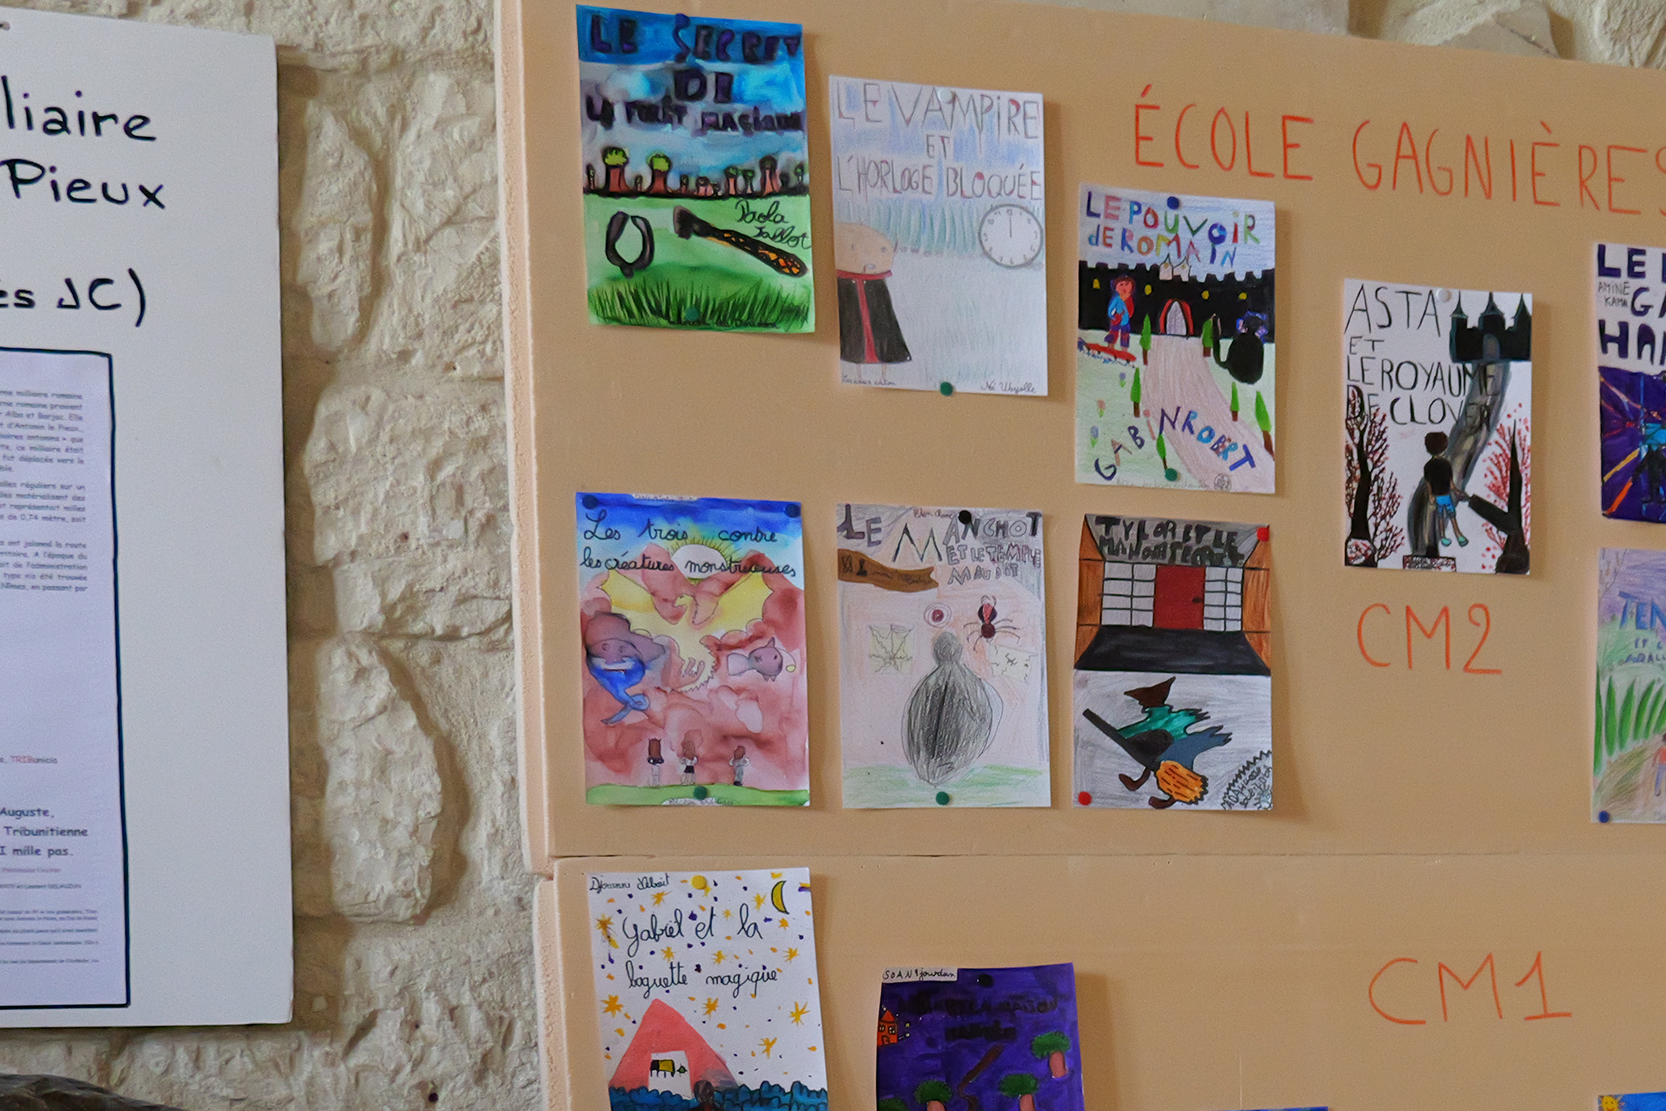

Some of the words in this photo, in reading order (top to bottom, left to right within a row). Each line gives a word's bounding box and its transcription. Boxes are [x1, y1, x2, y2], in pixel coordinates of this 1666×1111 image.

[836, 80, 883, 124] LE
[924, 133, 951, 161] ET
[1134, 83, 1314, 182] ÉCOLE
[0, 158, 166, 210] Pieux
[1086, 190, 1122, 222] LE
[1597, 243, 1648, 280] LE
[1343, 283, 1442, 339] ASTA
[1348, 334, 1385, 356] ET
[1346, 355, 1376, 387] LE
[1380, 358, 1501, 399] ROYAUME
[583, 509, 621, 542] Les
[637, 523, 689, 542] trois
[718, 529, 778, 544] contre
[1356, 602, 1503, 676] CM2
[12, 845, 42, 857] mille
[695, 905, 717, 941] et
[736, 902, 764, 941] la
[704, 968, 778, 999] magique
[1368, 950, 1573, 1025] CM1
